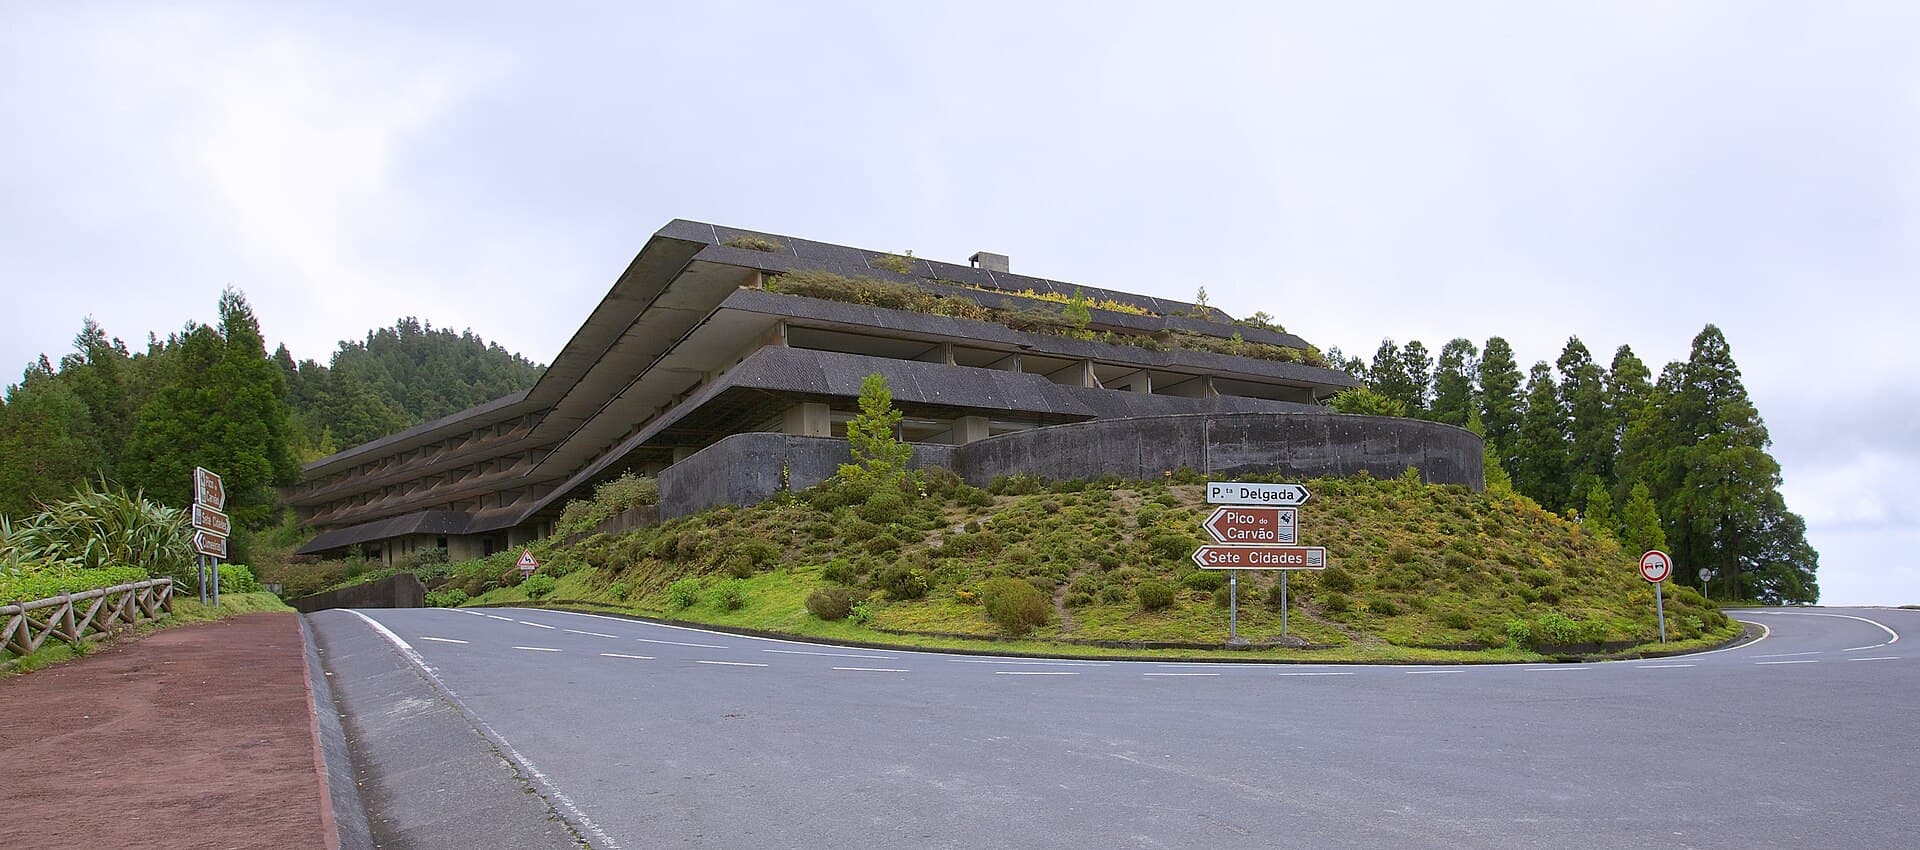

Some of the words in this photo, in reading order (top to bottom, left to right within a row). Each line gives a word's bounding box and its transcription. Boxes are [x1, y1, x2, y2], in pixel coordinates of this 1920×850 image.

[1240, 488, 1294, 501] Delgada
[1227, 512, 1254, 524] Pico
[1227, 527, 1274, 540] Carvão
[1209, 551, 1240, 563] Sete
[1249, 551, 1303, 564] Cidades
